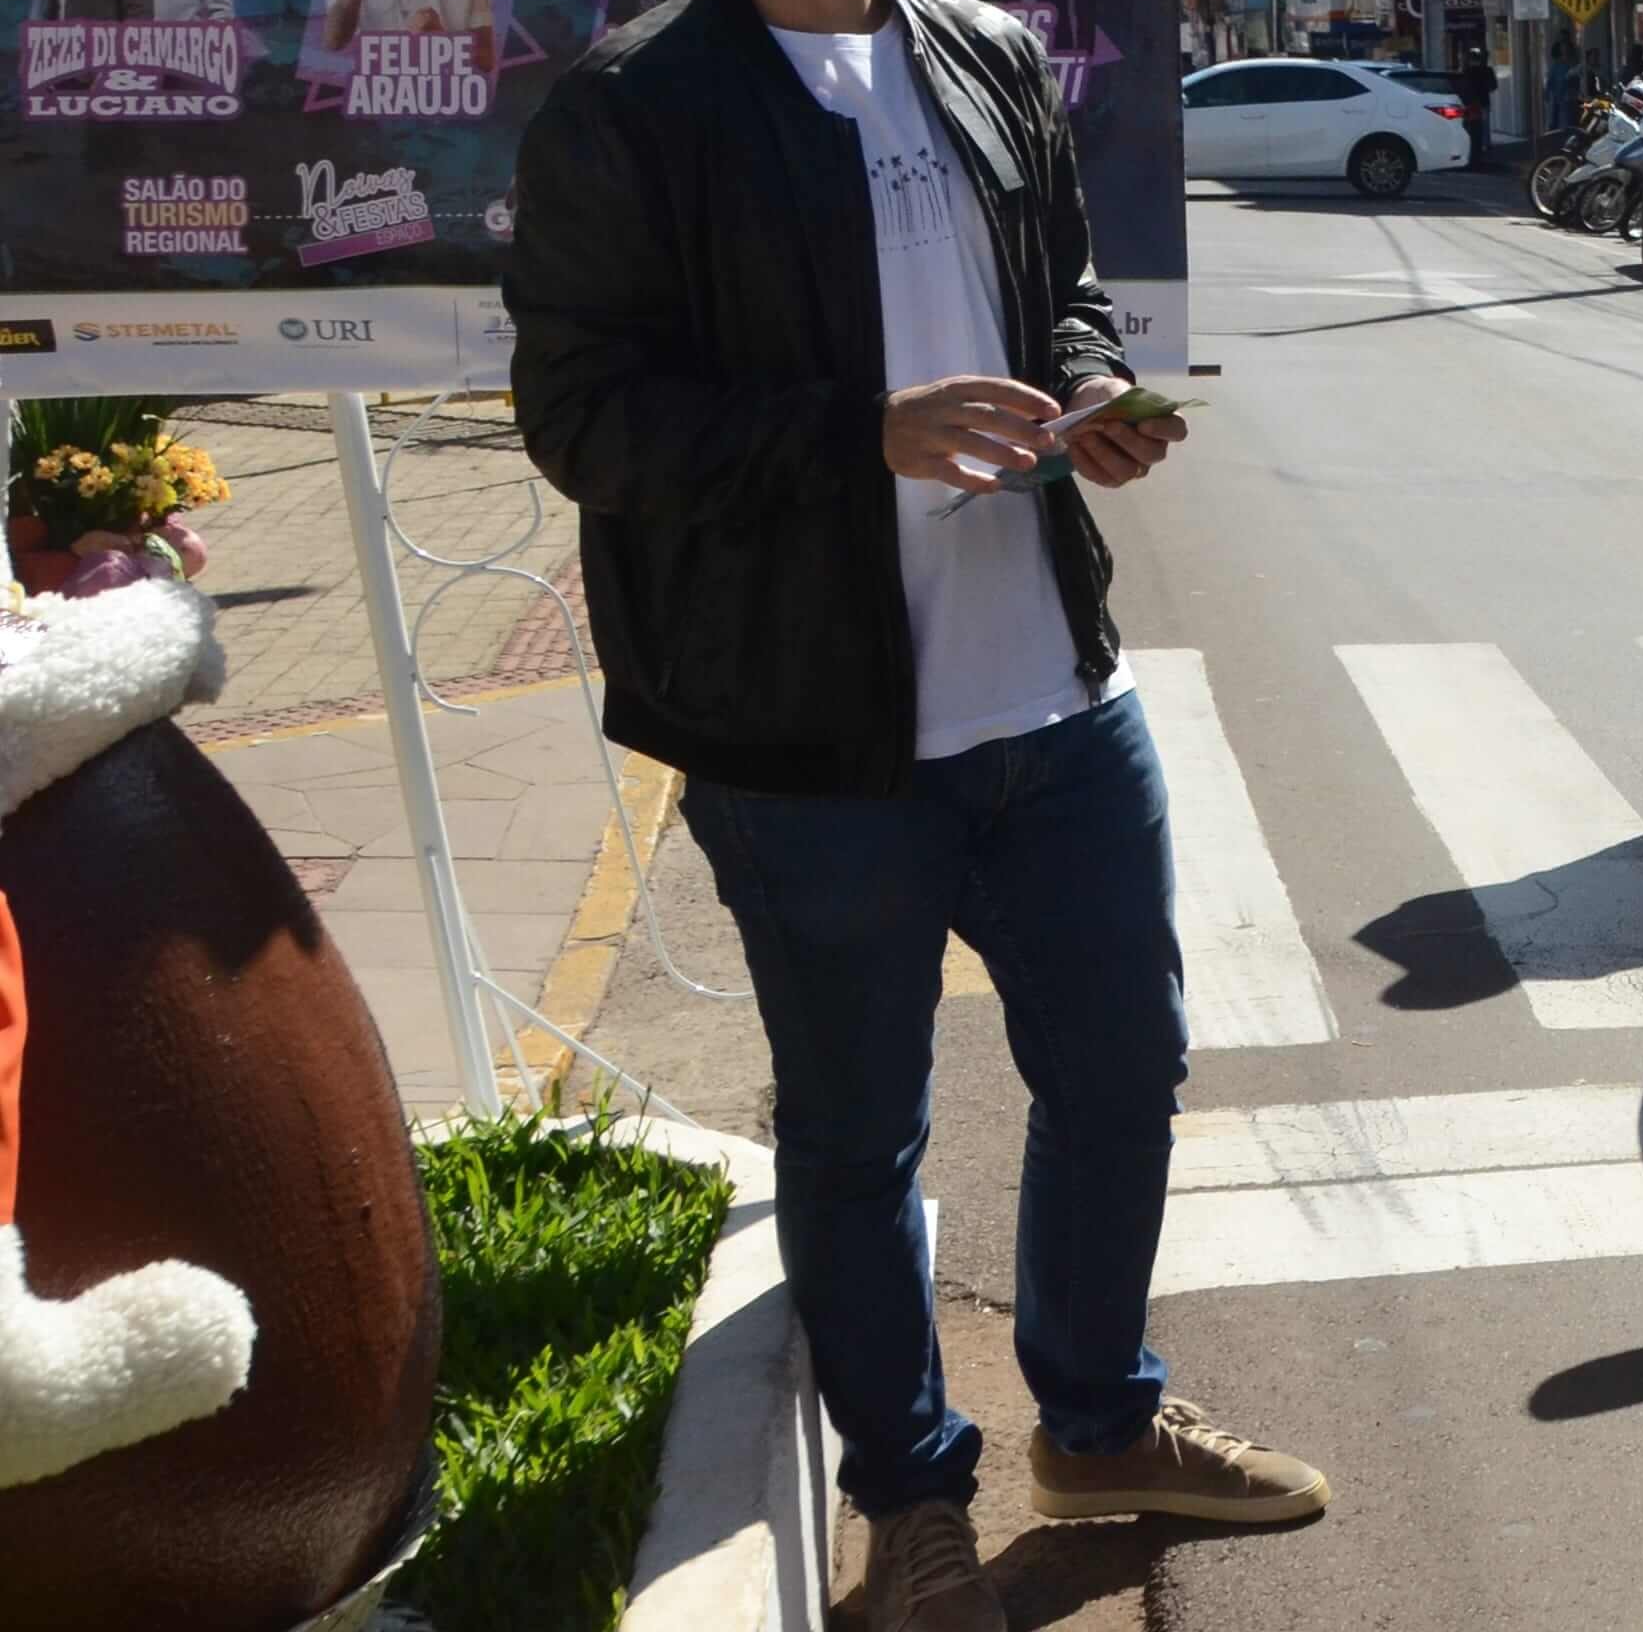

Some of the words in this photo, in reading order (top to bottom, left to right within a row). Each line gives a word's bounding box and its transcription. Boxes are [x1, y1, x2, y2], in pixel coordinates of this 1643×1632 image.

[92, 26, 117, 67] DI
[123, 25, 238, 94] CAMARGO
[360, 36, 473, 75] FELIPE
[104, 69, 158, 91] &
[29, 95, 239, 116] LUCIANO
[347, 74, 487, 115] ARAÚJO
[124, 174, 205, 201] SALÃO
[212, 179, 245, 201] DO
[124, 203, 248, 227] TURISMO
[126, 231, 248, 253] REGIONAL
[106, 323, 238, 337] STEMETAL
[312, 320, 375, 341] URI
